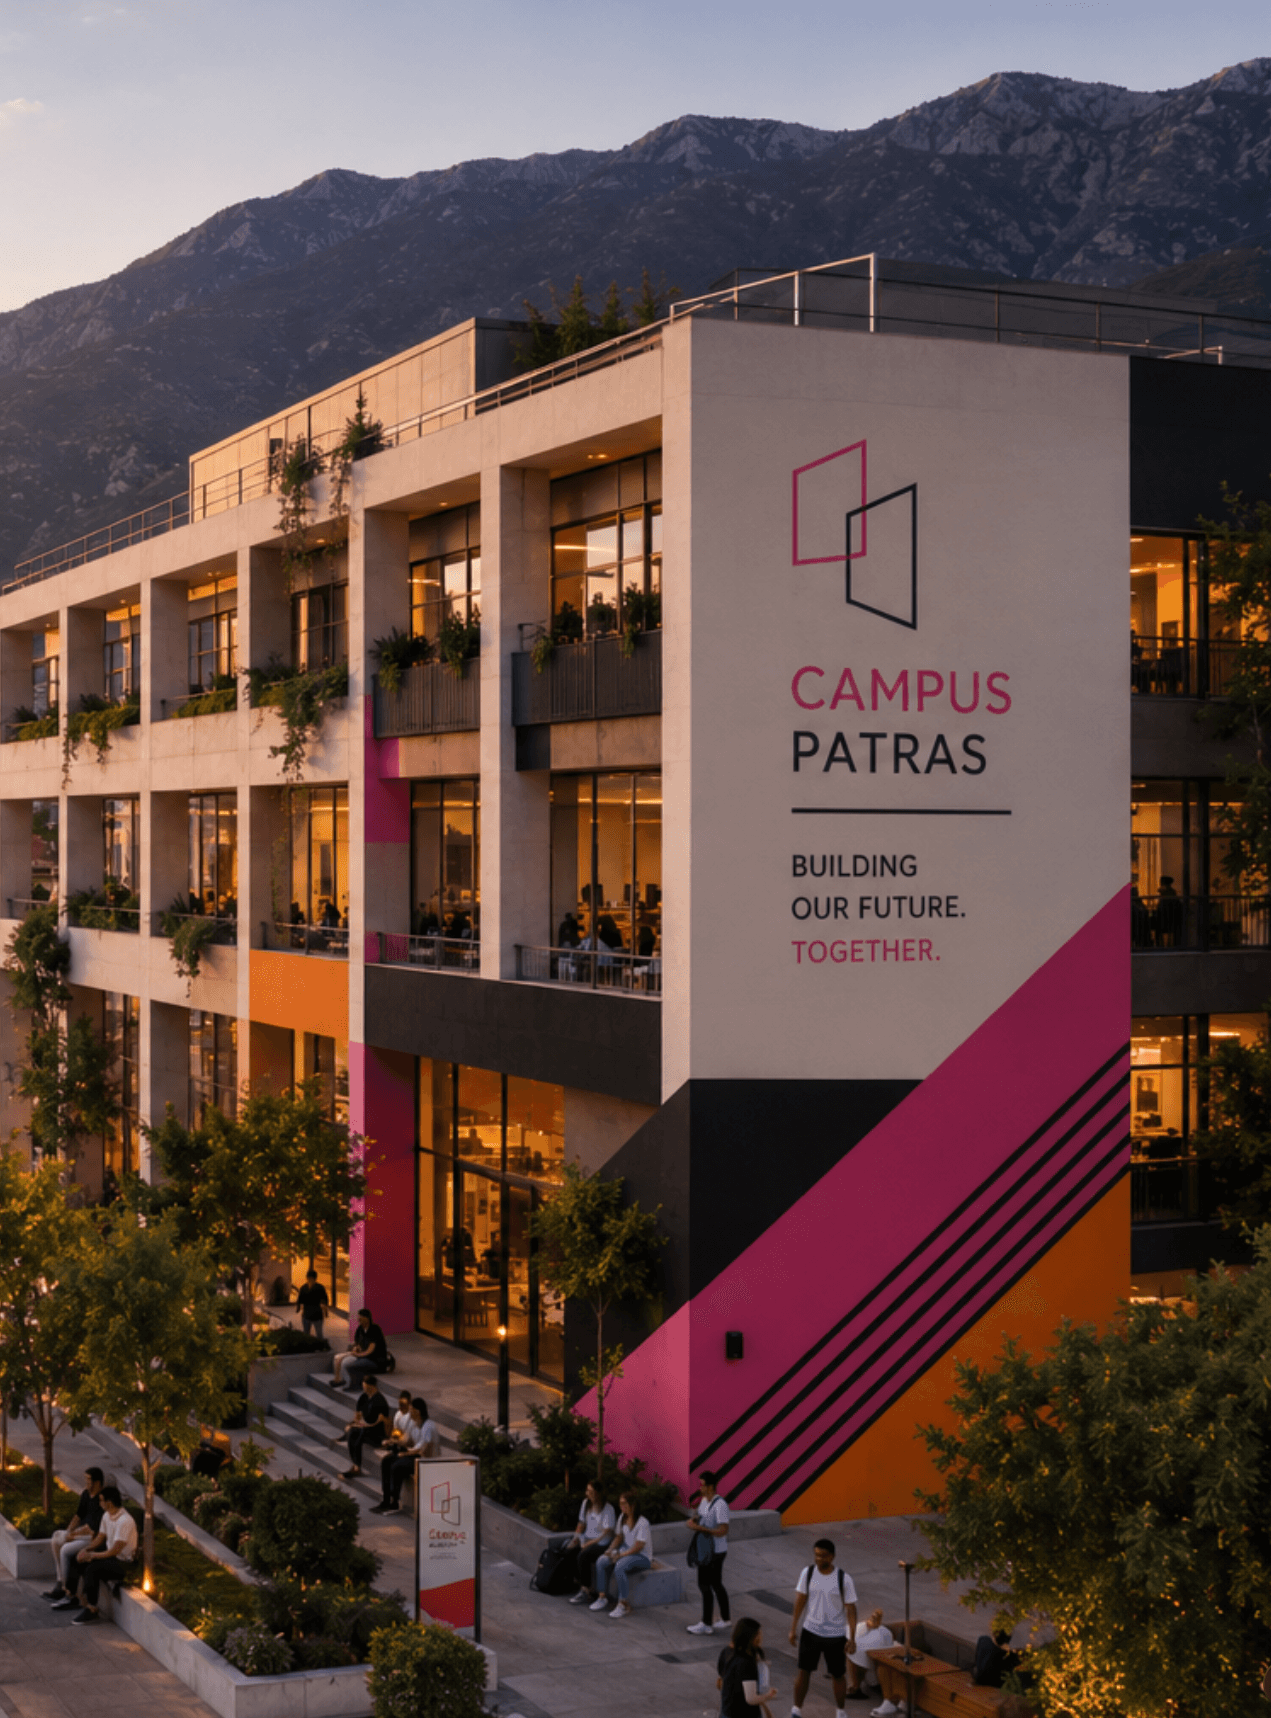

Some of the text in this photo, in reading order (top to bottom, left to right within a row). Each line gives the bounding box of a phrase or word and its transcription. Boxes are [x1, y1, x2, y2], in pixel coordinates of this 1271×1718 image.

[792, 665, 1012, 715] CAMPUS
[793, 730, 987, 775] PATRAS
[792, 854, 918, 878] BUILDING
[791, 895, 966, 921] OUR FUTURE.
[791, 939, 941, 964] TOGETHER.
